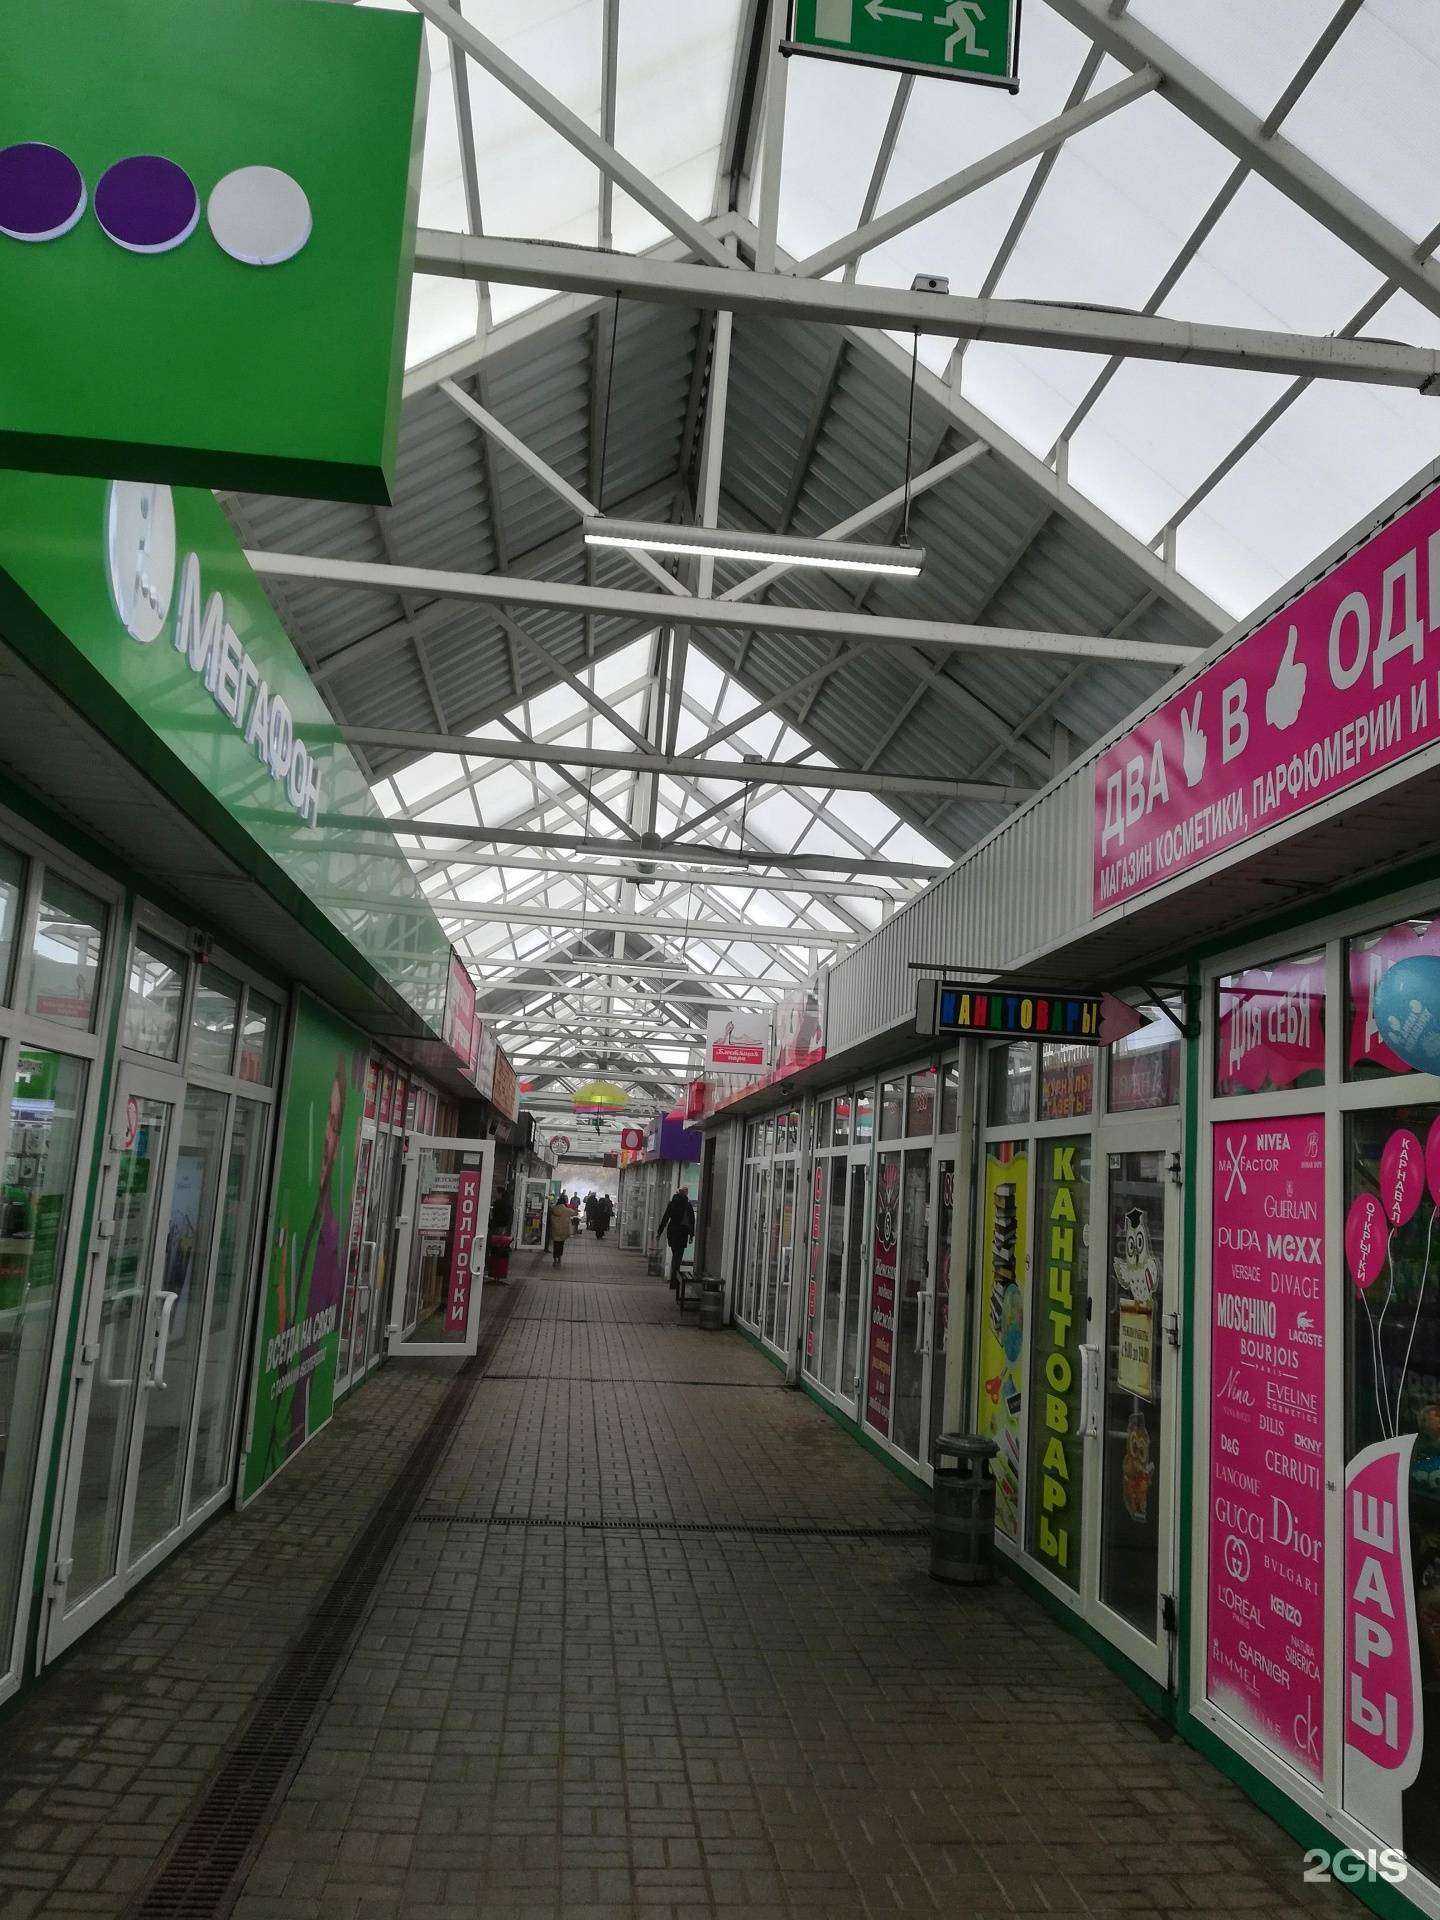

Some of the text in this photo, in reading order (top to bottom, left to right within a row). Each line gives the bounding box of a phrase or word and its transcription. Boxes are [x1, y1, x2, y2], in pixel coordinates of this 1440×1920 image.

[174, 551, 321, 830] МЕГАФОН
[1101, 740, 1170, 857] ДВА
[1222, 678, 1250, 765] В
[1099, 679, 1428, 900] МАГАЗИН КОСМЕТИКИ, ПАРФЮМЕРИИ И
[941, 991, 1098, 1034] КАНЦТОВАРЫ
[1229, 996, 1262, 1076] ДЛЯ
[1267, 973, 1311, 1049] СЕБЯ
[1256, 1133, 1291, 1151] NIVEA
[1391, 1138, 1410, 1223] КАРНАВАЛ
[1264, 1195, 1318, 1221] GUERLAIN
[450, 1181, 476, 1321] КОЛГОТКИ
[1217, 1226, 1261, 1252] PUPA
[1271, 1272, 1320, 1300] DIVAGE
[1217, 1292, 1277, 1339] MOSCHINO
[1039, 1146, 1078, 1568] КАНЦТОВАРЫ
[1240, 1338, 1299, 1369] BOURJOIS
[1288, 1328, 1323, 1348] LACOSTE
[1216, 1366, 1255, 1406] Nina
[1266, 1381, 1319, 1411] EVELINE
[1220, 1434, 1240, 1456] D&G
[1259, 1413, 1286, 1437] DILIS
[1294, 1433, 1324, 1453] DKNY
[1265, 1449, 1320, 1490] CERRUTI
[1215, 1498, 1265, 1544] GUCCI
[1270, 1495, 1322, 1564] Dior
[1264, 1554, 1319, 1596] BVLGARI
[1270, 1593, 1303, 1628] KENZO
[1351, 1489, 1399, 1750] ШАРЫ
[1212, 1644, 1260, 1692] RIMMEL
[1285, 1645, 1322, 1684] SIBERICA
